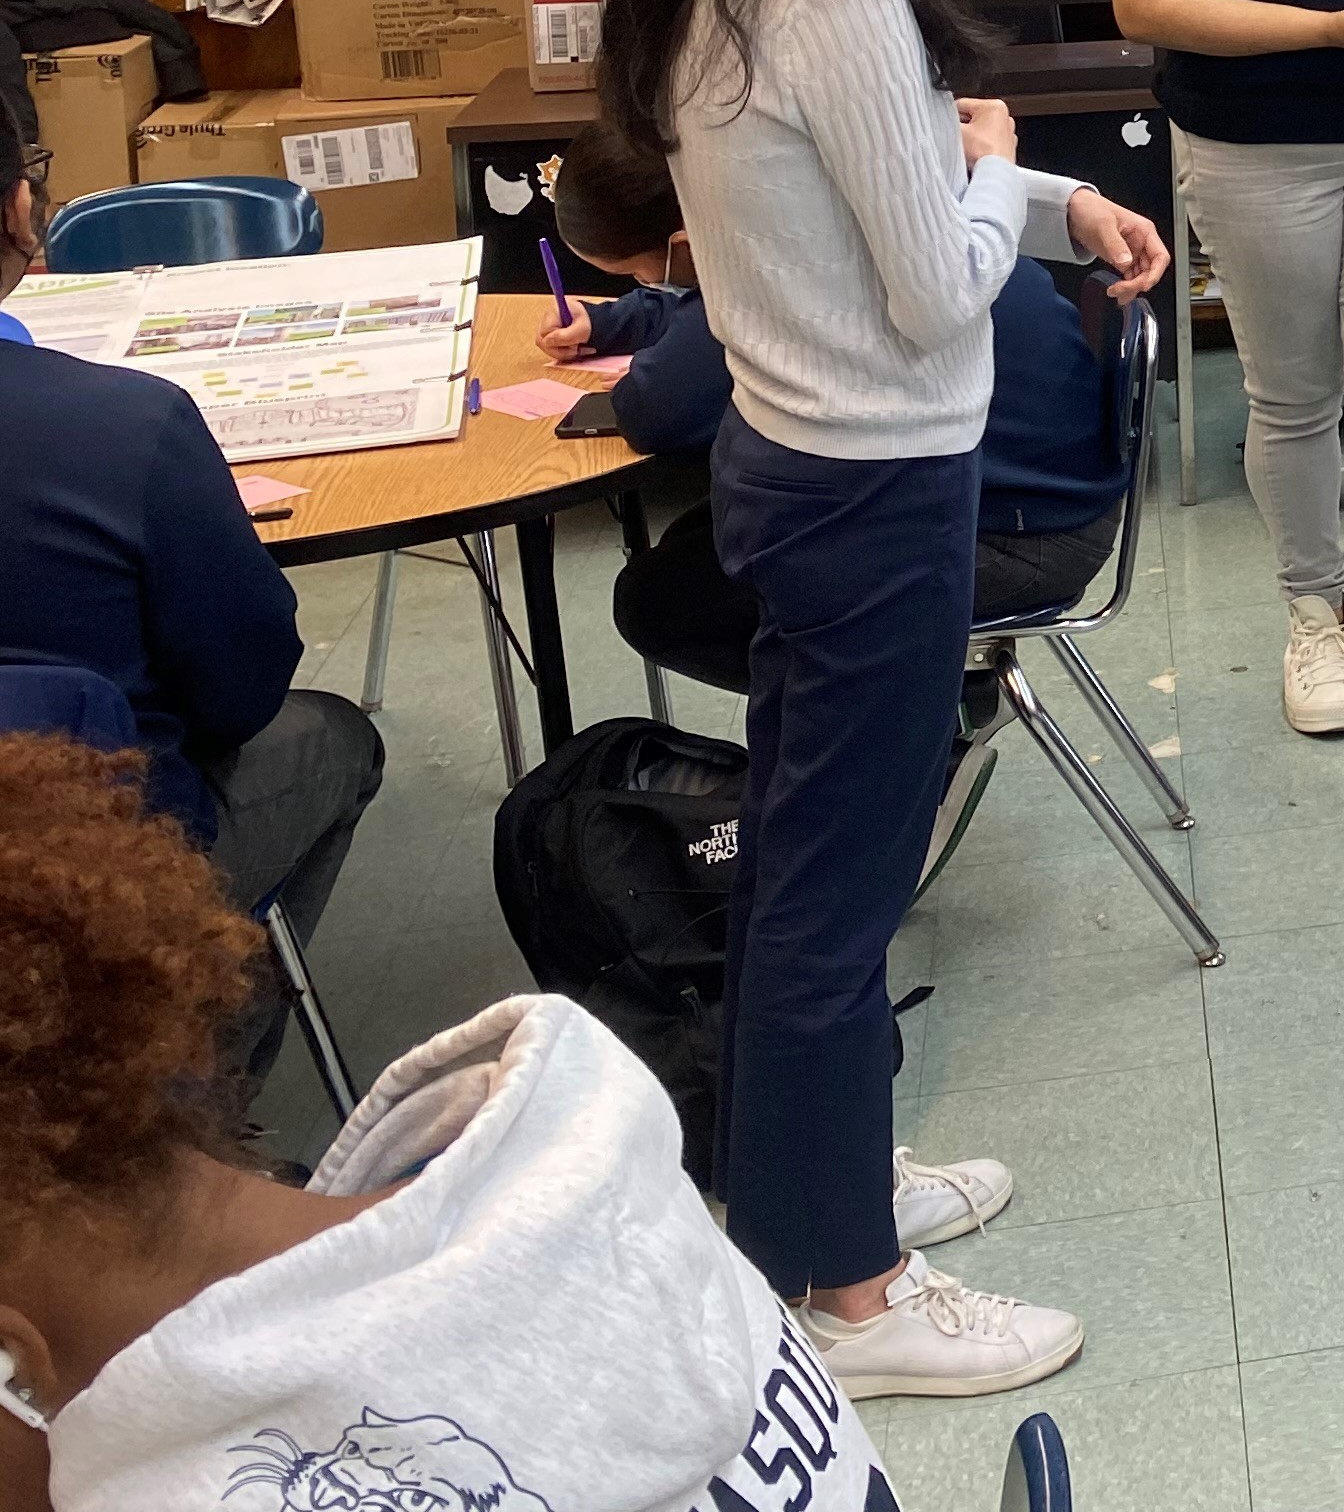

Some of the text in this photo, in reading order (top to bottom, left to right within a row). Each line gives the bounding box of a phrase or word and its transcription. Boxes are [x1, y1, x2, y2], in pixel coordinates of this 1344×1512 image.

[179, 124, 226, 136] Thule
[710, 819, 739, 836] THE
[705, 845, 738, 864] FAC
